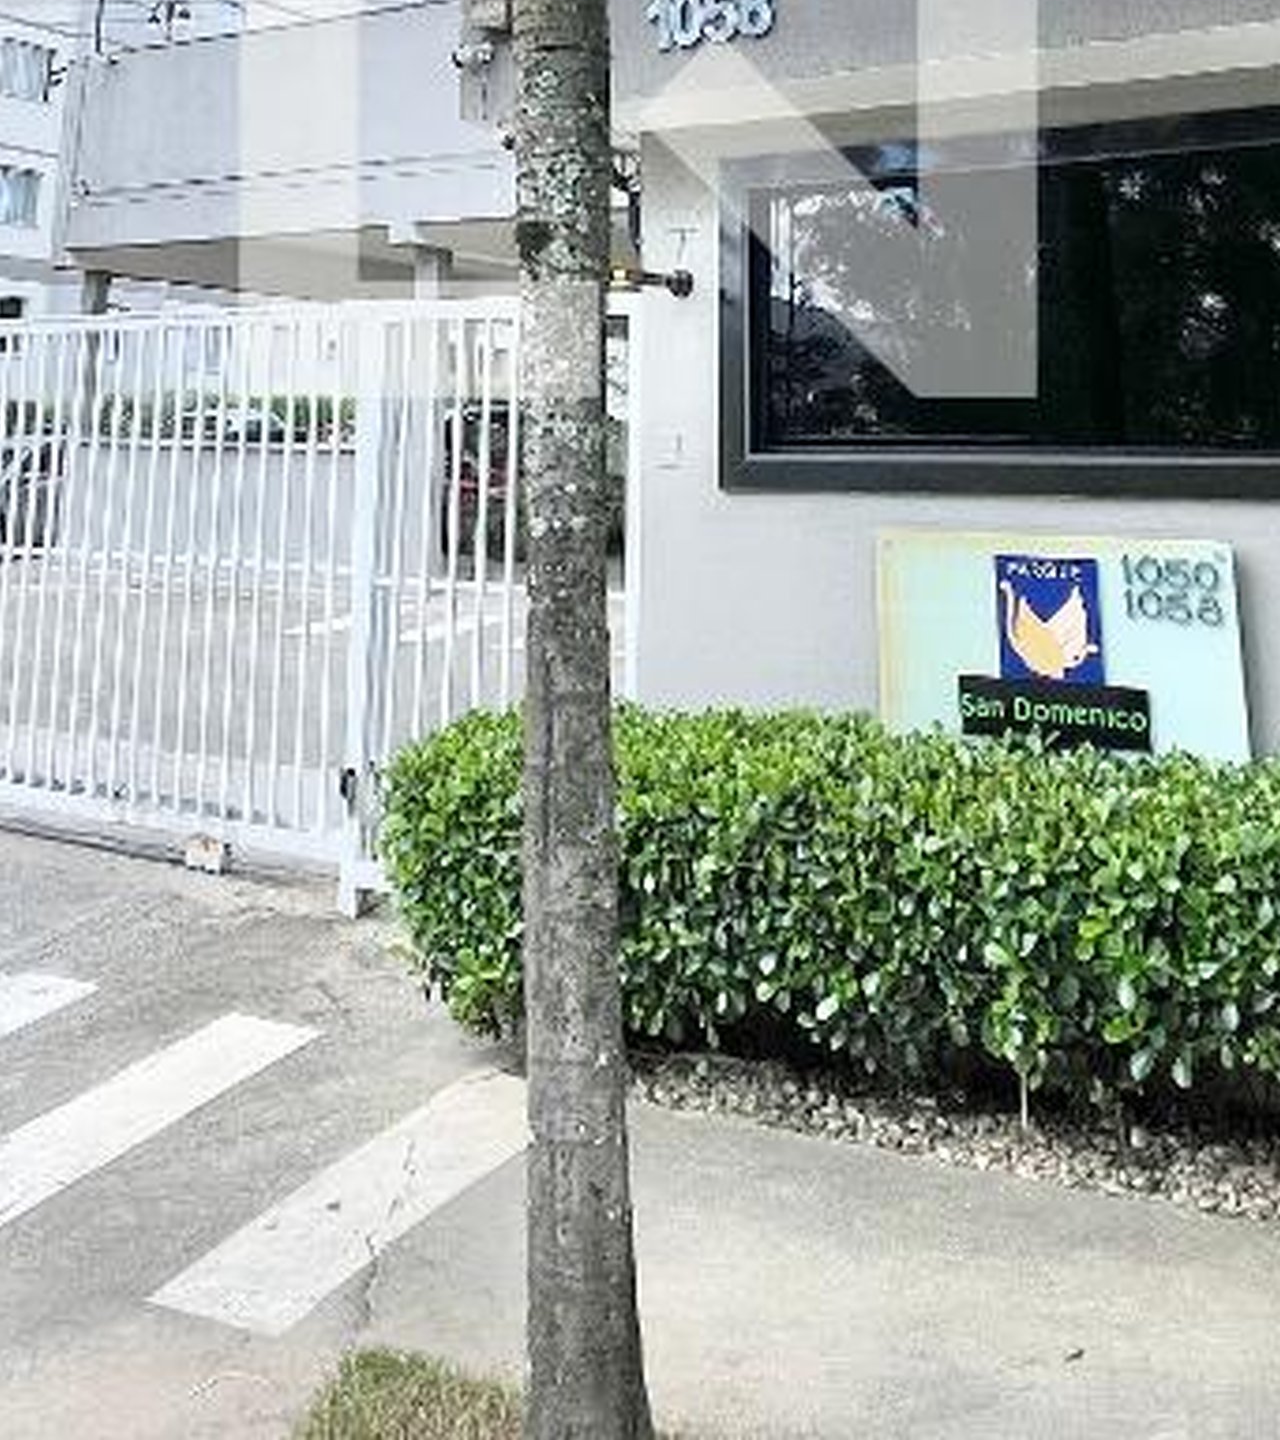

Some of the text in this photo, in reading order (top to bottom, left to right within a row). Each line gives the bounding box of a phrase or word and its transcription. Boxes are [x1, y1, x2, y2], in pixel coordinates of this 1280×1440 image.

[1121, 553, 1219, 593] 1050
[961, 692, 1148, 733] San Domenico
